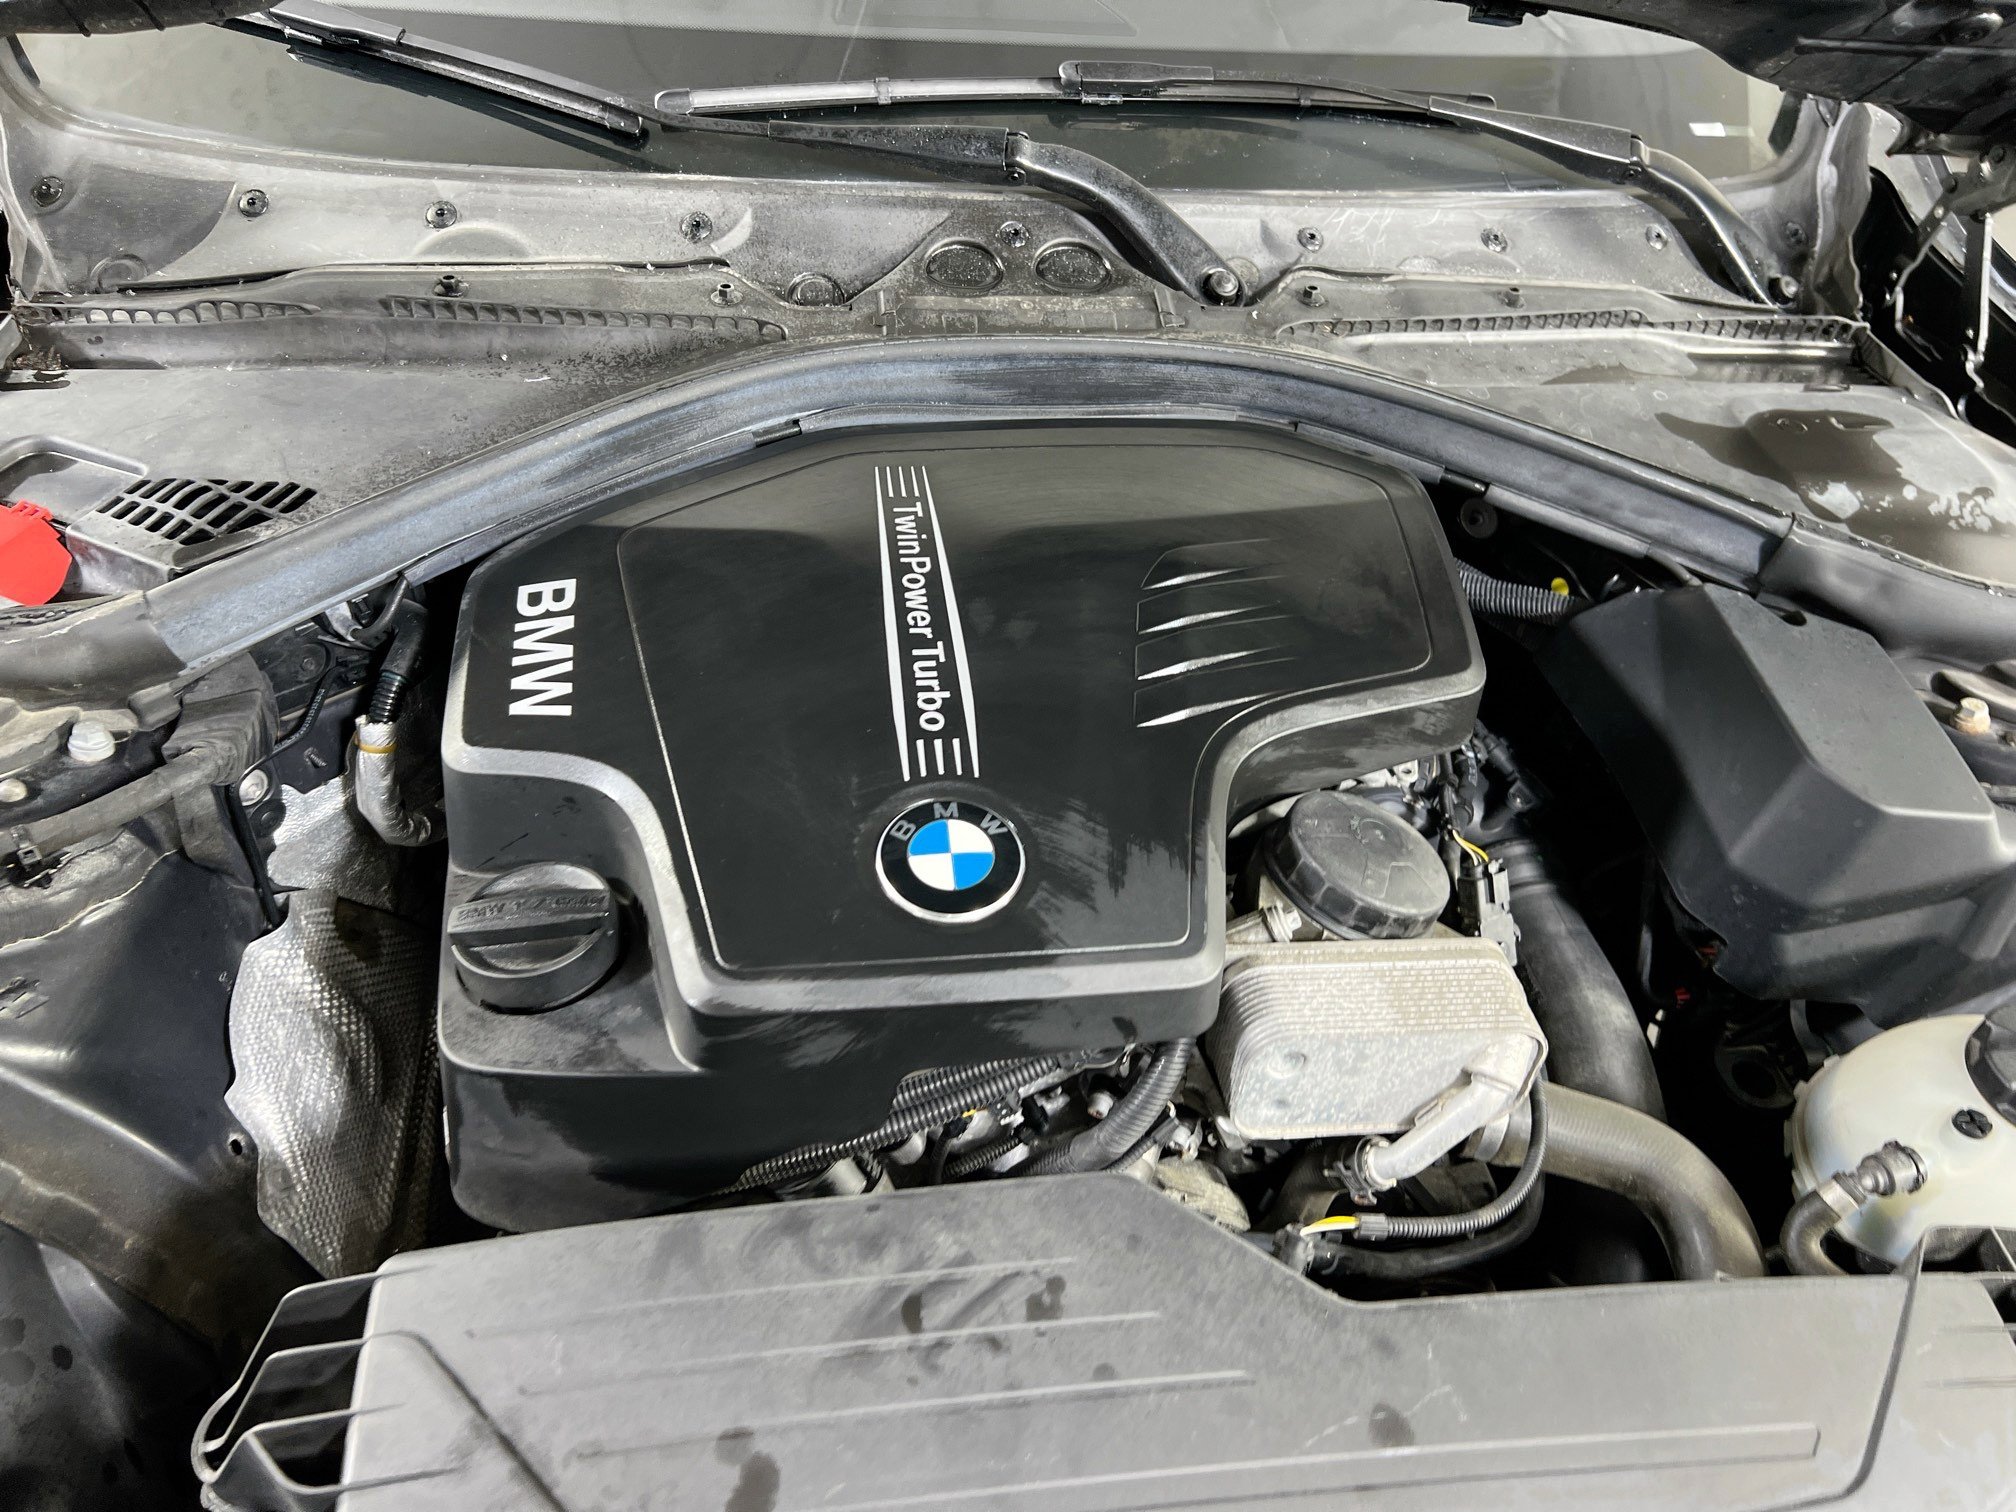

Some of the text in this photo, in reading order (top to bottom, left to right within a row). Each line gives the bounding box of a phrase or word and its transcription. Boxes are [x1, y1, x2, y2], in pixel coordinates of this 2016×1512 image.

[509, 579, 577, 716] BMW
[893, 502, 951, 732] TwinPower Turbo
[890, 802, 1008, 841] BMW
